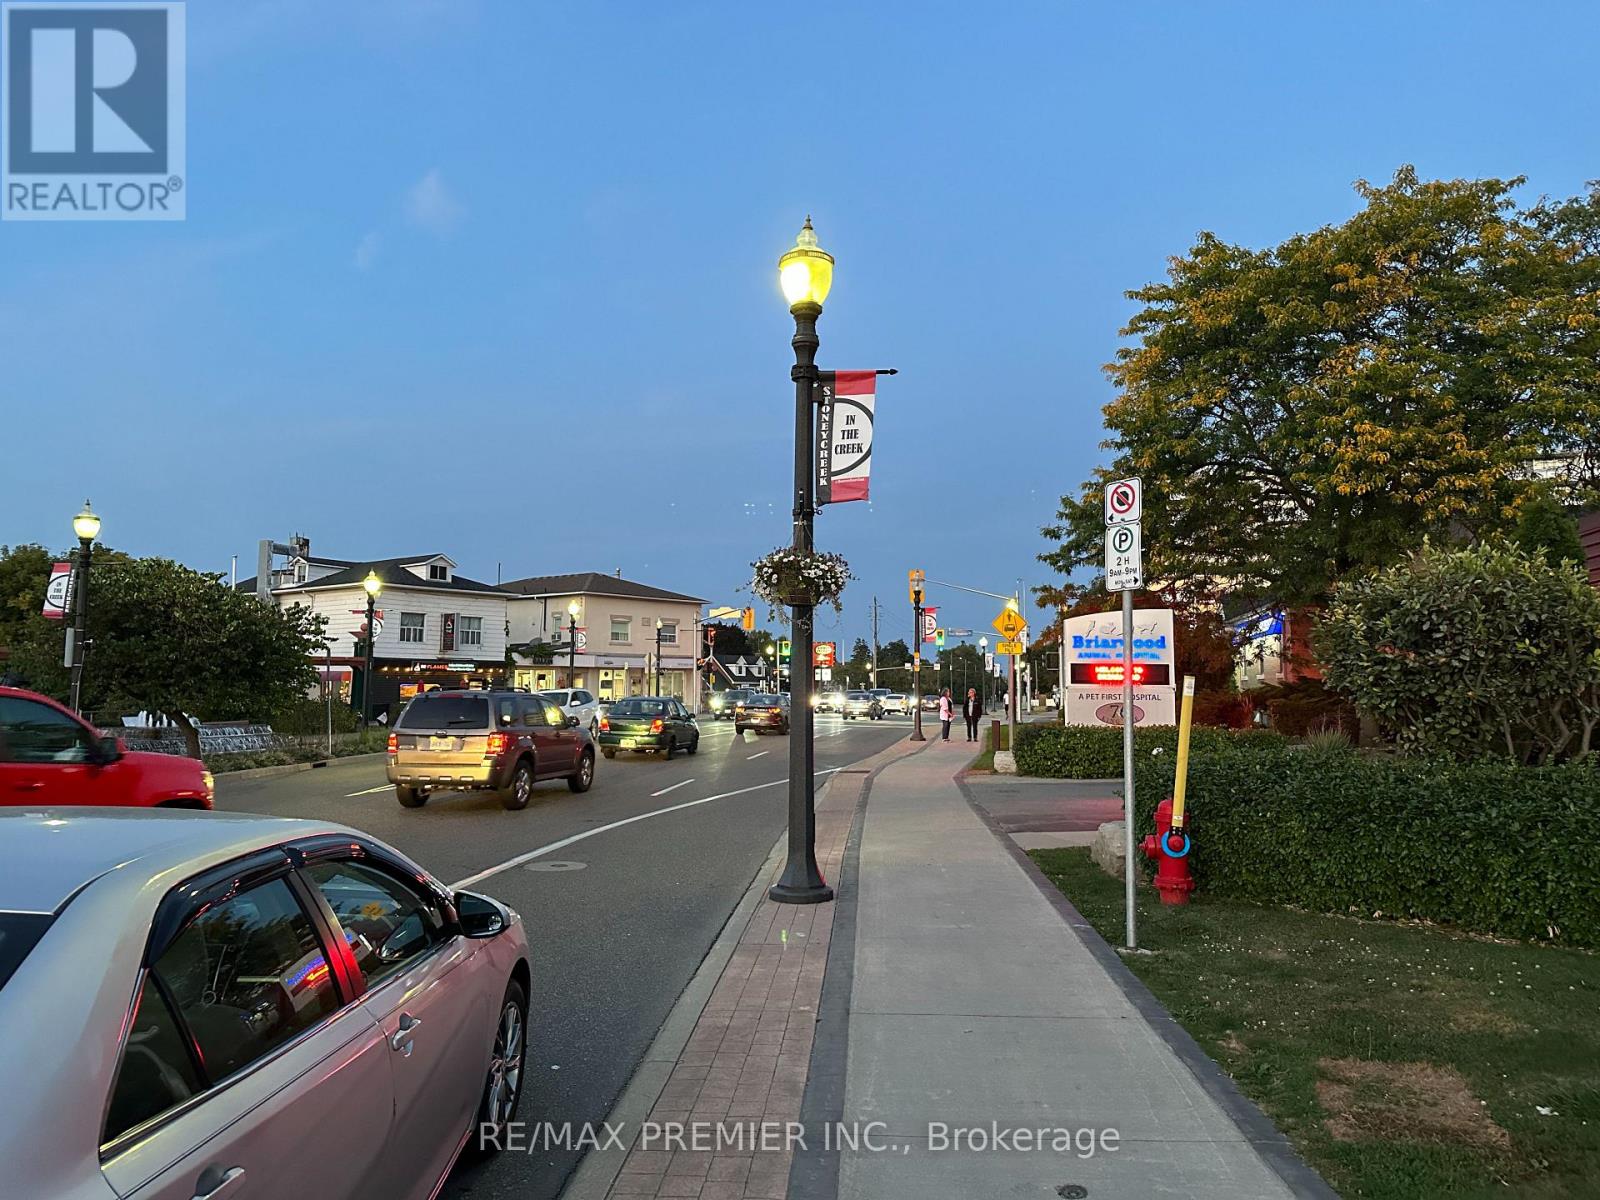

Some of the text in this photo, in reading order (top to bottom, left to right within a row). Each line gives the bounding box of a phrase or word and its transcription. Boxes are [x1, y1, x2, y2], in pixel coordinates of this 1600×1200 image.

[845, 414, 856, 426] IN
[819, 386, 831, 486] STONEYCREEK
[841, 429, 859, 440] THE
[834, 443, 864, 455] CREEK
[1118, 532, 1129, 549] P
[1116, 556, 1130, 566] 2 H
[1072, 635, 1167, 649] Briarood
[1132, 693, 1161, 701] OSPITAL
